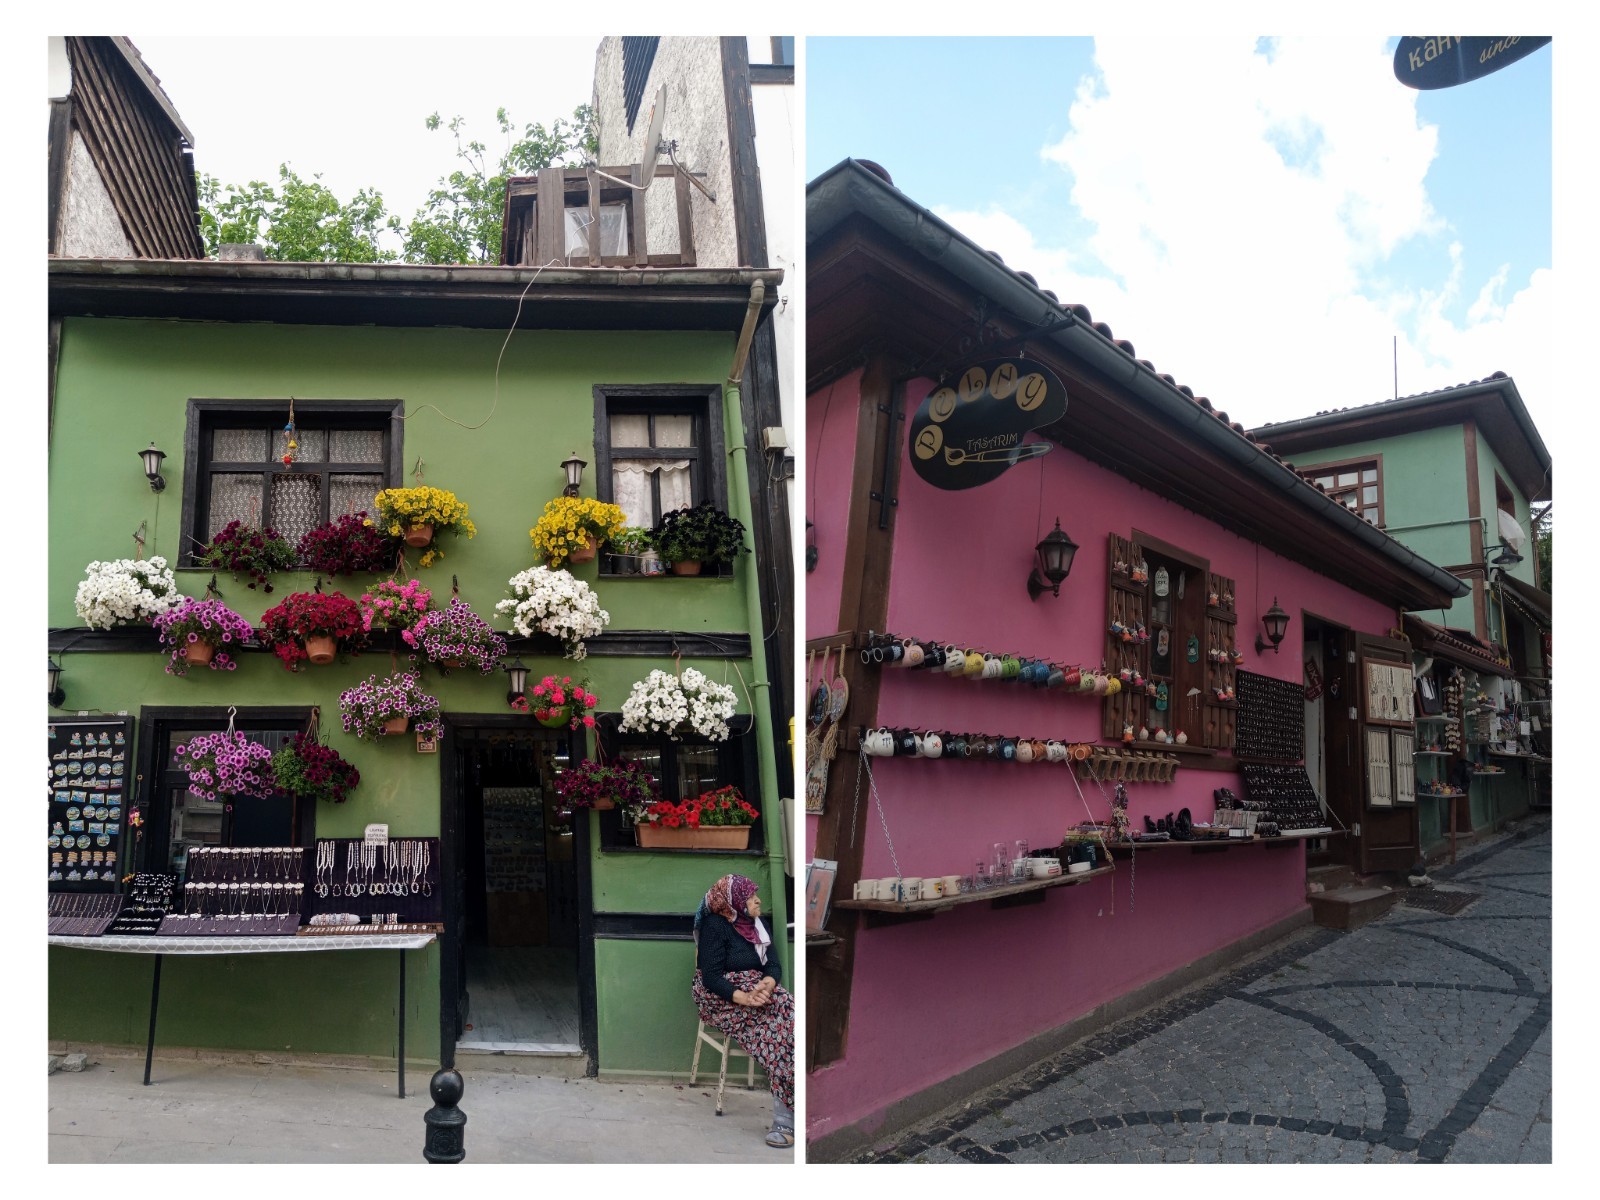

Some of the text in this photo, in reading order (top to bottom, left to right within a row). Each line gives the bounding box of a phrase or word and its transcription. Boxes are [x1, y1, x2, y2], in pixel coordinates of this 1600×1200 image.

[1479, 36, 1520, 64] since
[966, 432, 1018, 451] TASARIM
[1306, 662, 1322, 693] EXIT
